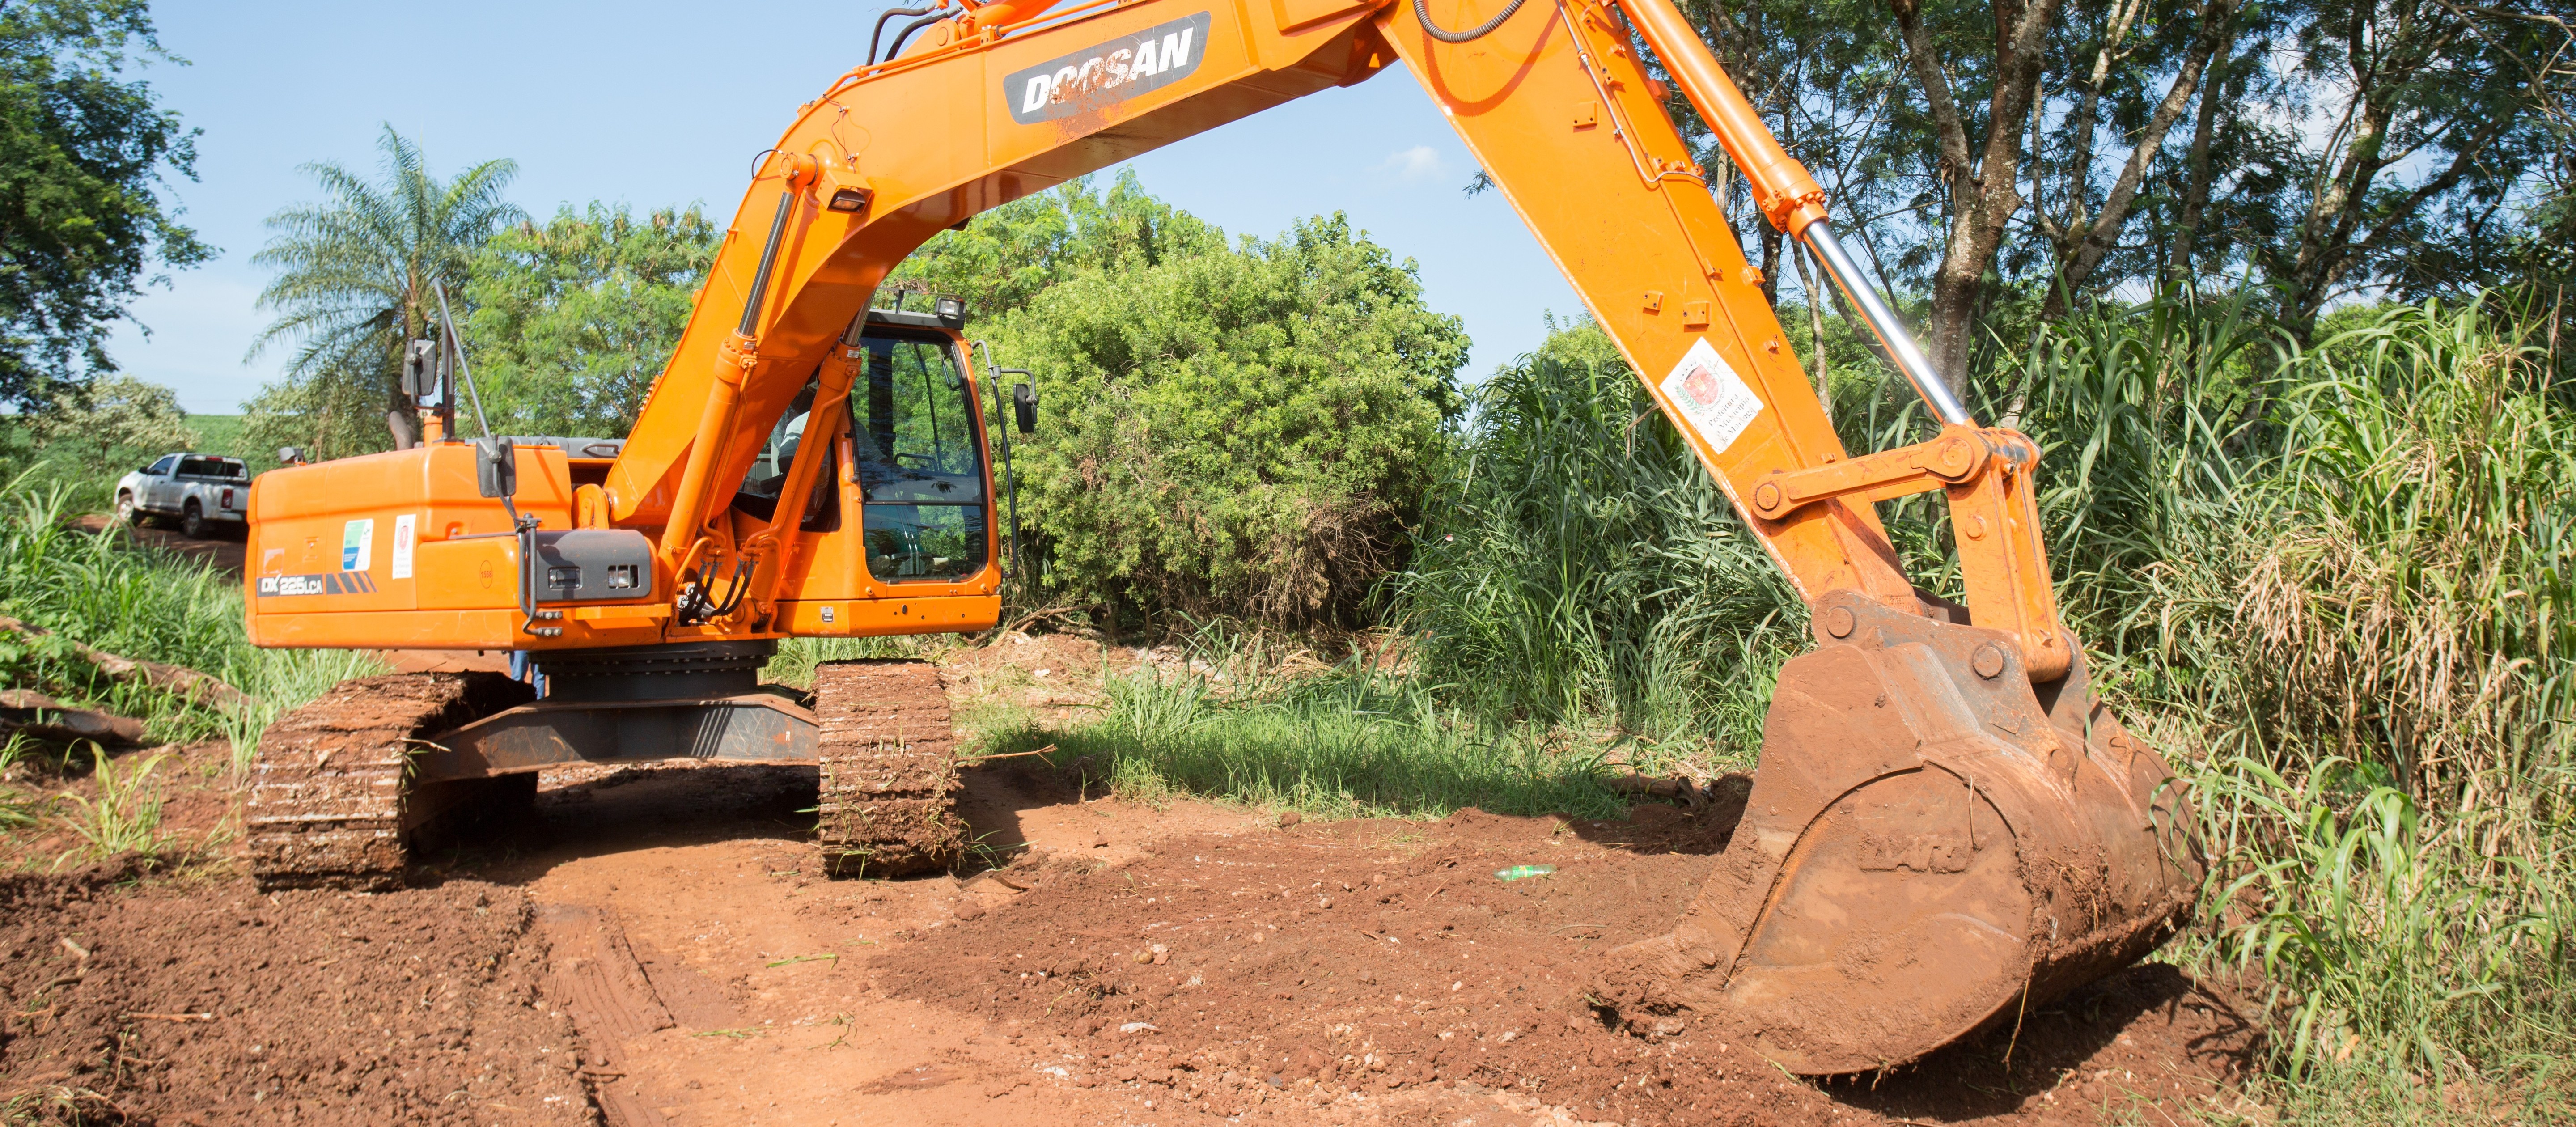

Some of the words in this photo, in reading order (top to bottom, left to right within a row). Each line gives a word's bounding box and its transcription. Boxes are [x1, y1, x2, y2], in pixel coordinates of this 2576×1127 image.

[1022, 27, 1194, 114] DOOSAN
[1709, 394, 1738, 427] Prefeitura
[1728, 408, 1754, 436] Marng
[481, 570, 492, 579] 1558
